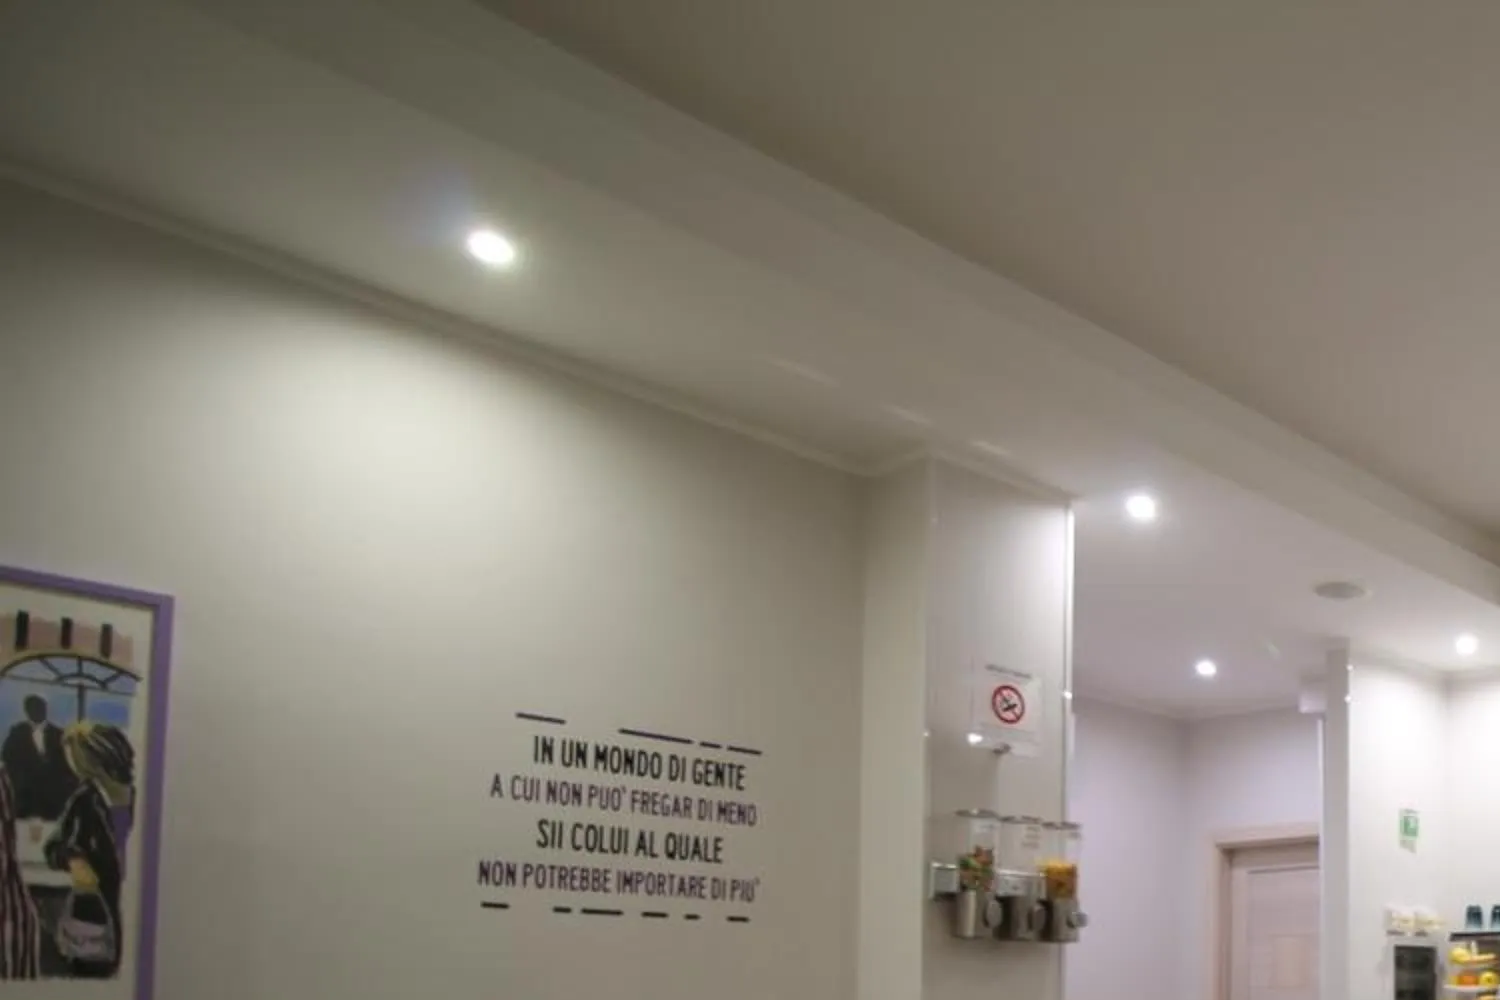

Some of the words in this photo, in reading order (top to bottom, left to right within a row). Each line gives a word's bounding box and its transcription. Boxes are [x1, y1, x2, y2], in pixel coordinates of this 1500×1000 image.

[534, 735, 554, 764] IN
[561, 738, 588, 769] UN
[594, 743, 662, 779] MONDO
[668, 753, 687, 783] DI
[692, 757, 746, 791] GENTE
[490, 773, 504, 799] A
[511, 775, 541, 802] CUI
[546, 780, 582, 806] NON
[631, 788, 693, 819] FREGAR
[698, 797, 713, 822] DI
[717, 800, 757, 828] MENO
[536, 818, 564, 849] SII
[571, 822, 630, 855] COLUI
[634, 829, 659, 858] AL
[664, 831, 724, 864] QUALE
[478, 860, 517, 888] NON
[522, 863, 612, 893] POTREBBE
[616, 869, 707, 899] IMPORTARE
[710, 876, 727, 901] DI
